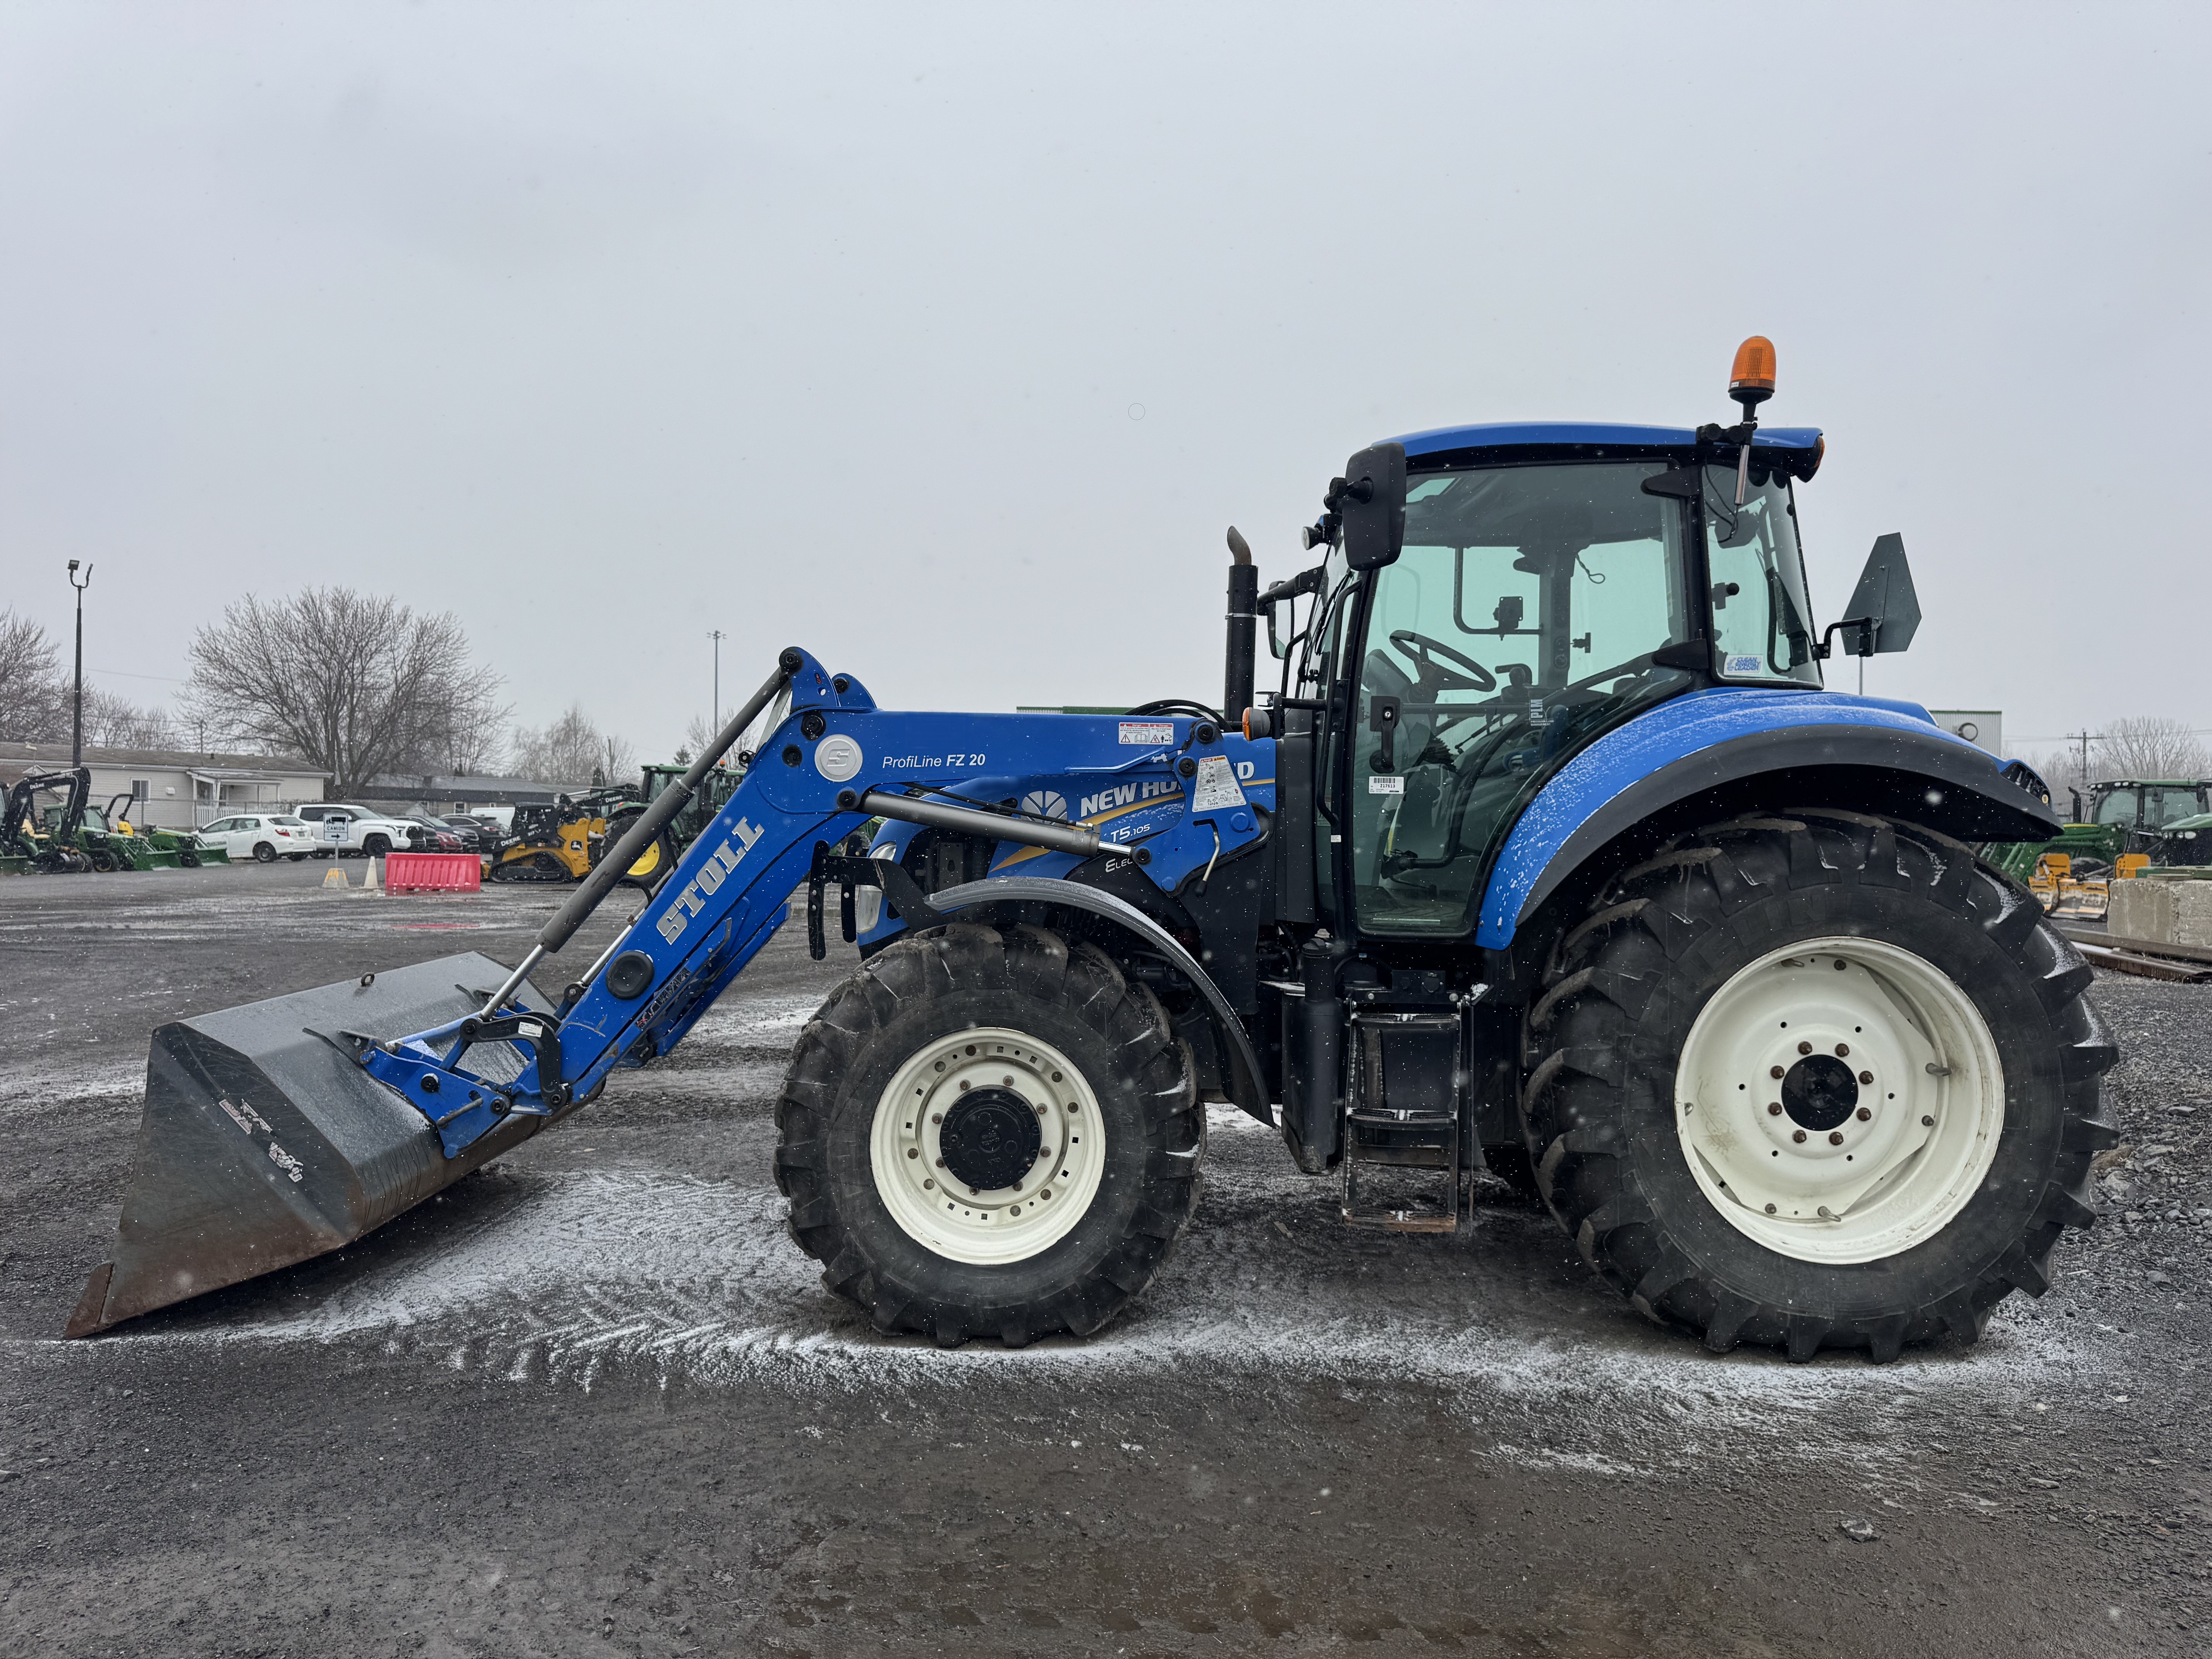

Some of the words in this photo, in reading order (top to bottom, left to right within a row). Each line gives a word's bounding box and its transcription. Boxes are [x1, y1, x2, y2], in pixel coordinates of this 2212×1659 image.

[1530, 699, 1543, 718] PLM
[883, 755, 942, 768] ProfiLine
[946, 754, 965, 766] FZ
[969, 754, 986, 766] 20
[1081, 782, 1137, 817] NEW
[501, 836, 521, 847] DEERE
[1110, 823, 1151, 843] T5.105
[1105, 858, 1133, 872] ELEC
[656, 816, 765, 946] STOLL
